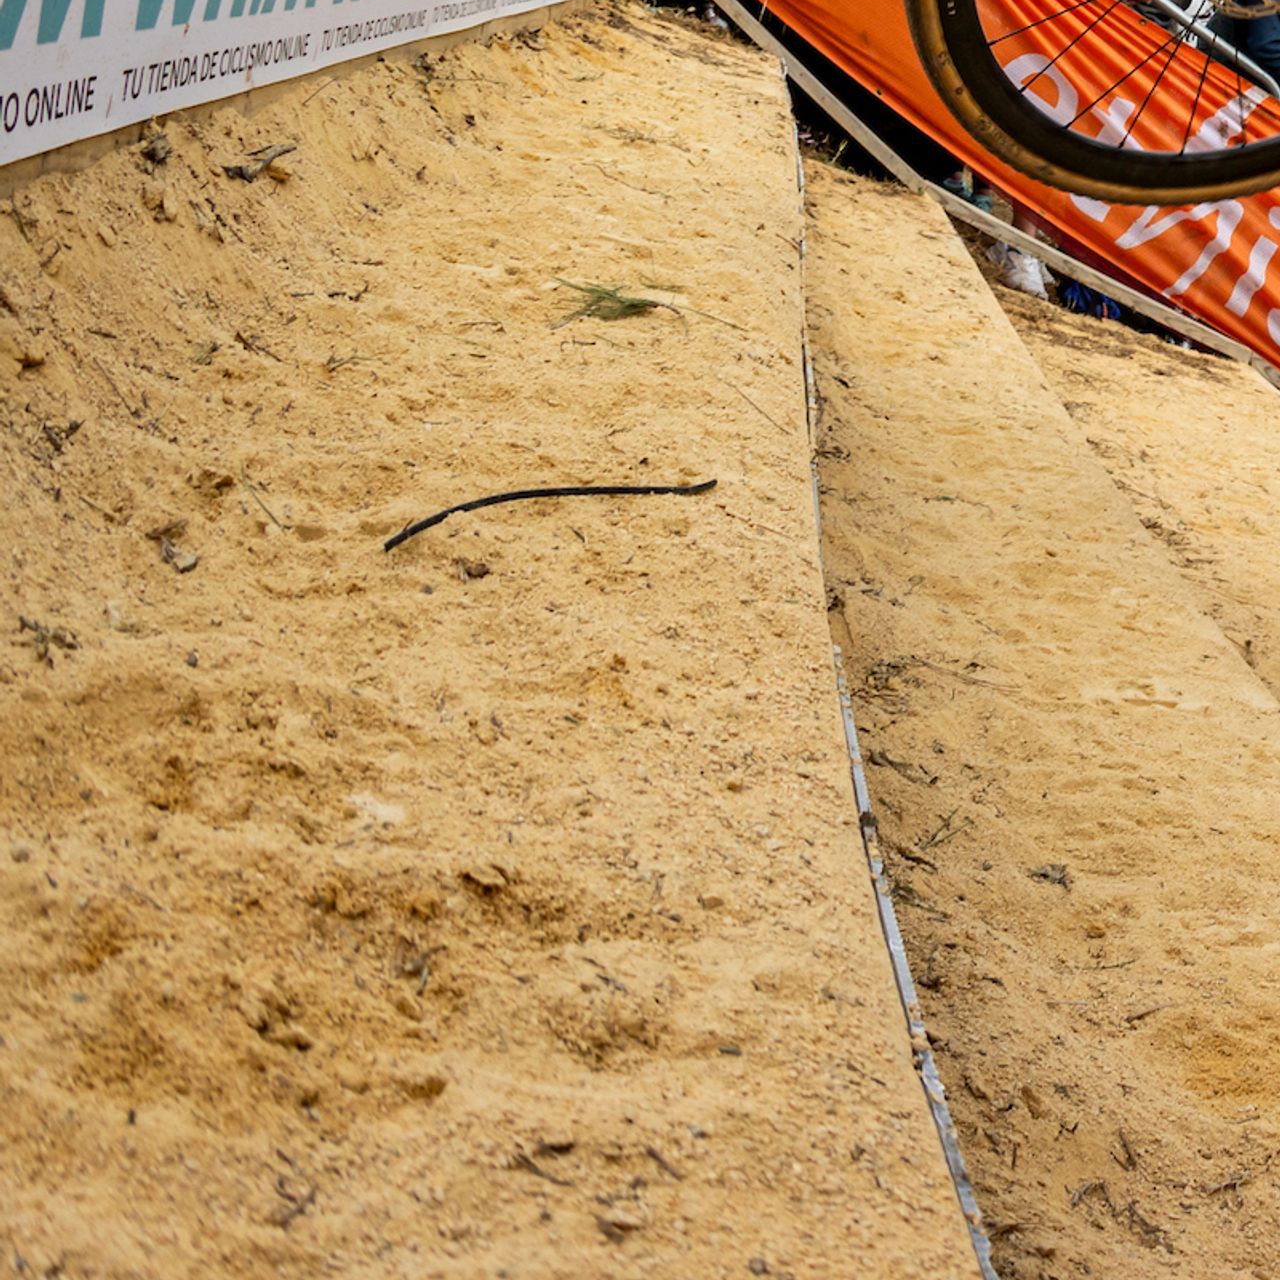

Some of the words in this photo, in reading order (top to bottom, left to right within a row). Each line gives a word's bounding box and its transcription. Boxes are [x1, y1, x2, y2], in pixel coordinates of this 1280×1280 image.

[123, 69, 142, 102] TU
[148, 57, 197, 93] TIENDA
[200, 52, 218, 82] DE
[219, 39, 273, 78] CICLISMO
[273, 33, 311, 64] ONLINE
[25, 76, 98, 127] ONLINE
